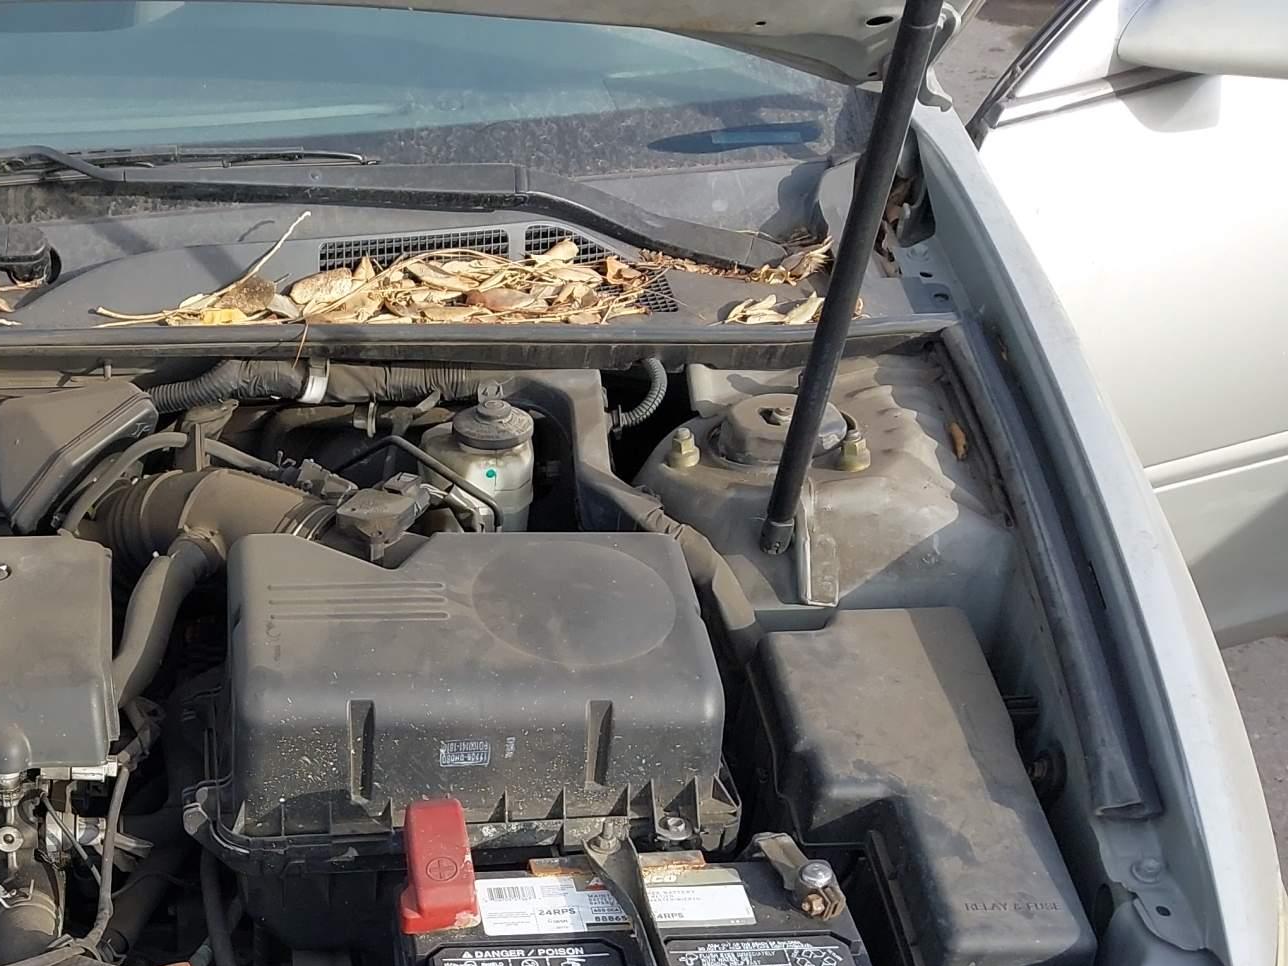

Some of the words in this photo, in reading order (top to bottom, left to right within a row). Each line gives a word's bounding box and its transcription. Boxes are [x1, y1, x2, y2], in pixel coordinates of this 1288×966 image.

[964, 902, 1008, 911] RELAY
[1026, 902, 1061, 911] FUSE
[538, 907, 576, 916] 24RPS
[475, 949, 525, 958] DANGER
[538, 947, 584, 956] POISON
